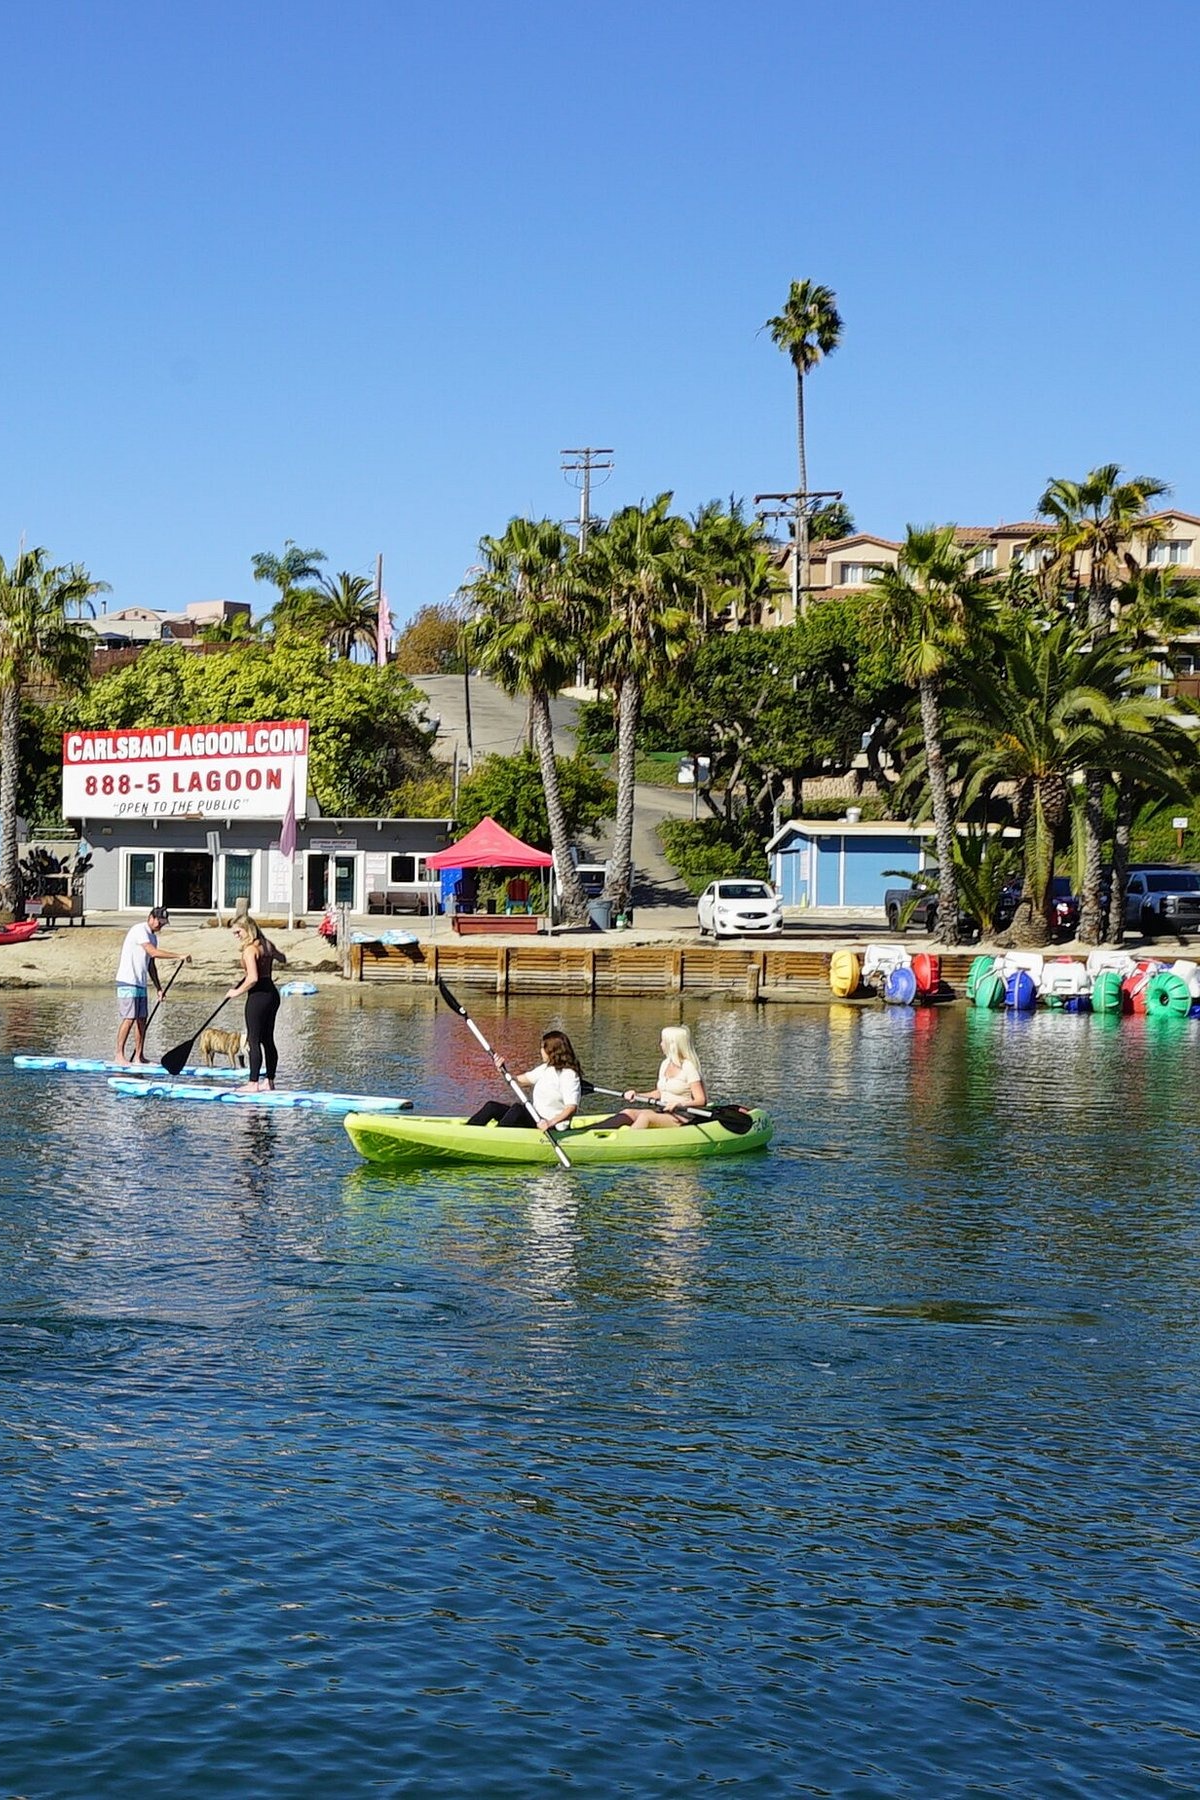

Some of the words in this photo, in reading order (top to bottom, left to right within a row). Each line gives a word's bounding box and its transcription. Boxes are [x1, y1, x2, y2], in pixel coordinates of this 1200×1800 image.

[85, 773, 161, 796] 888-5
[173, 768, 282, 793] LAGOON
[153, 801, 168, 812] TO
[171, 800, 195, 814] THE
